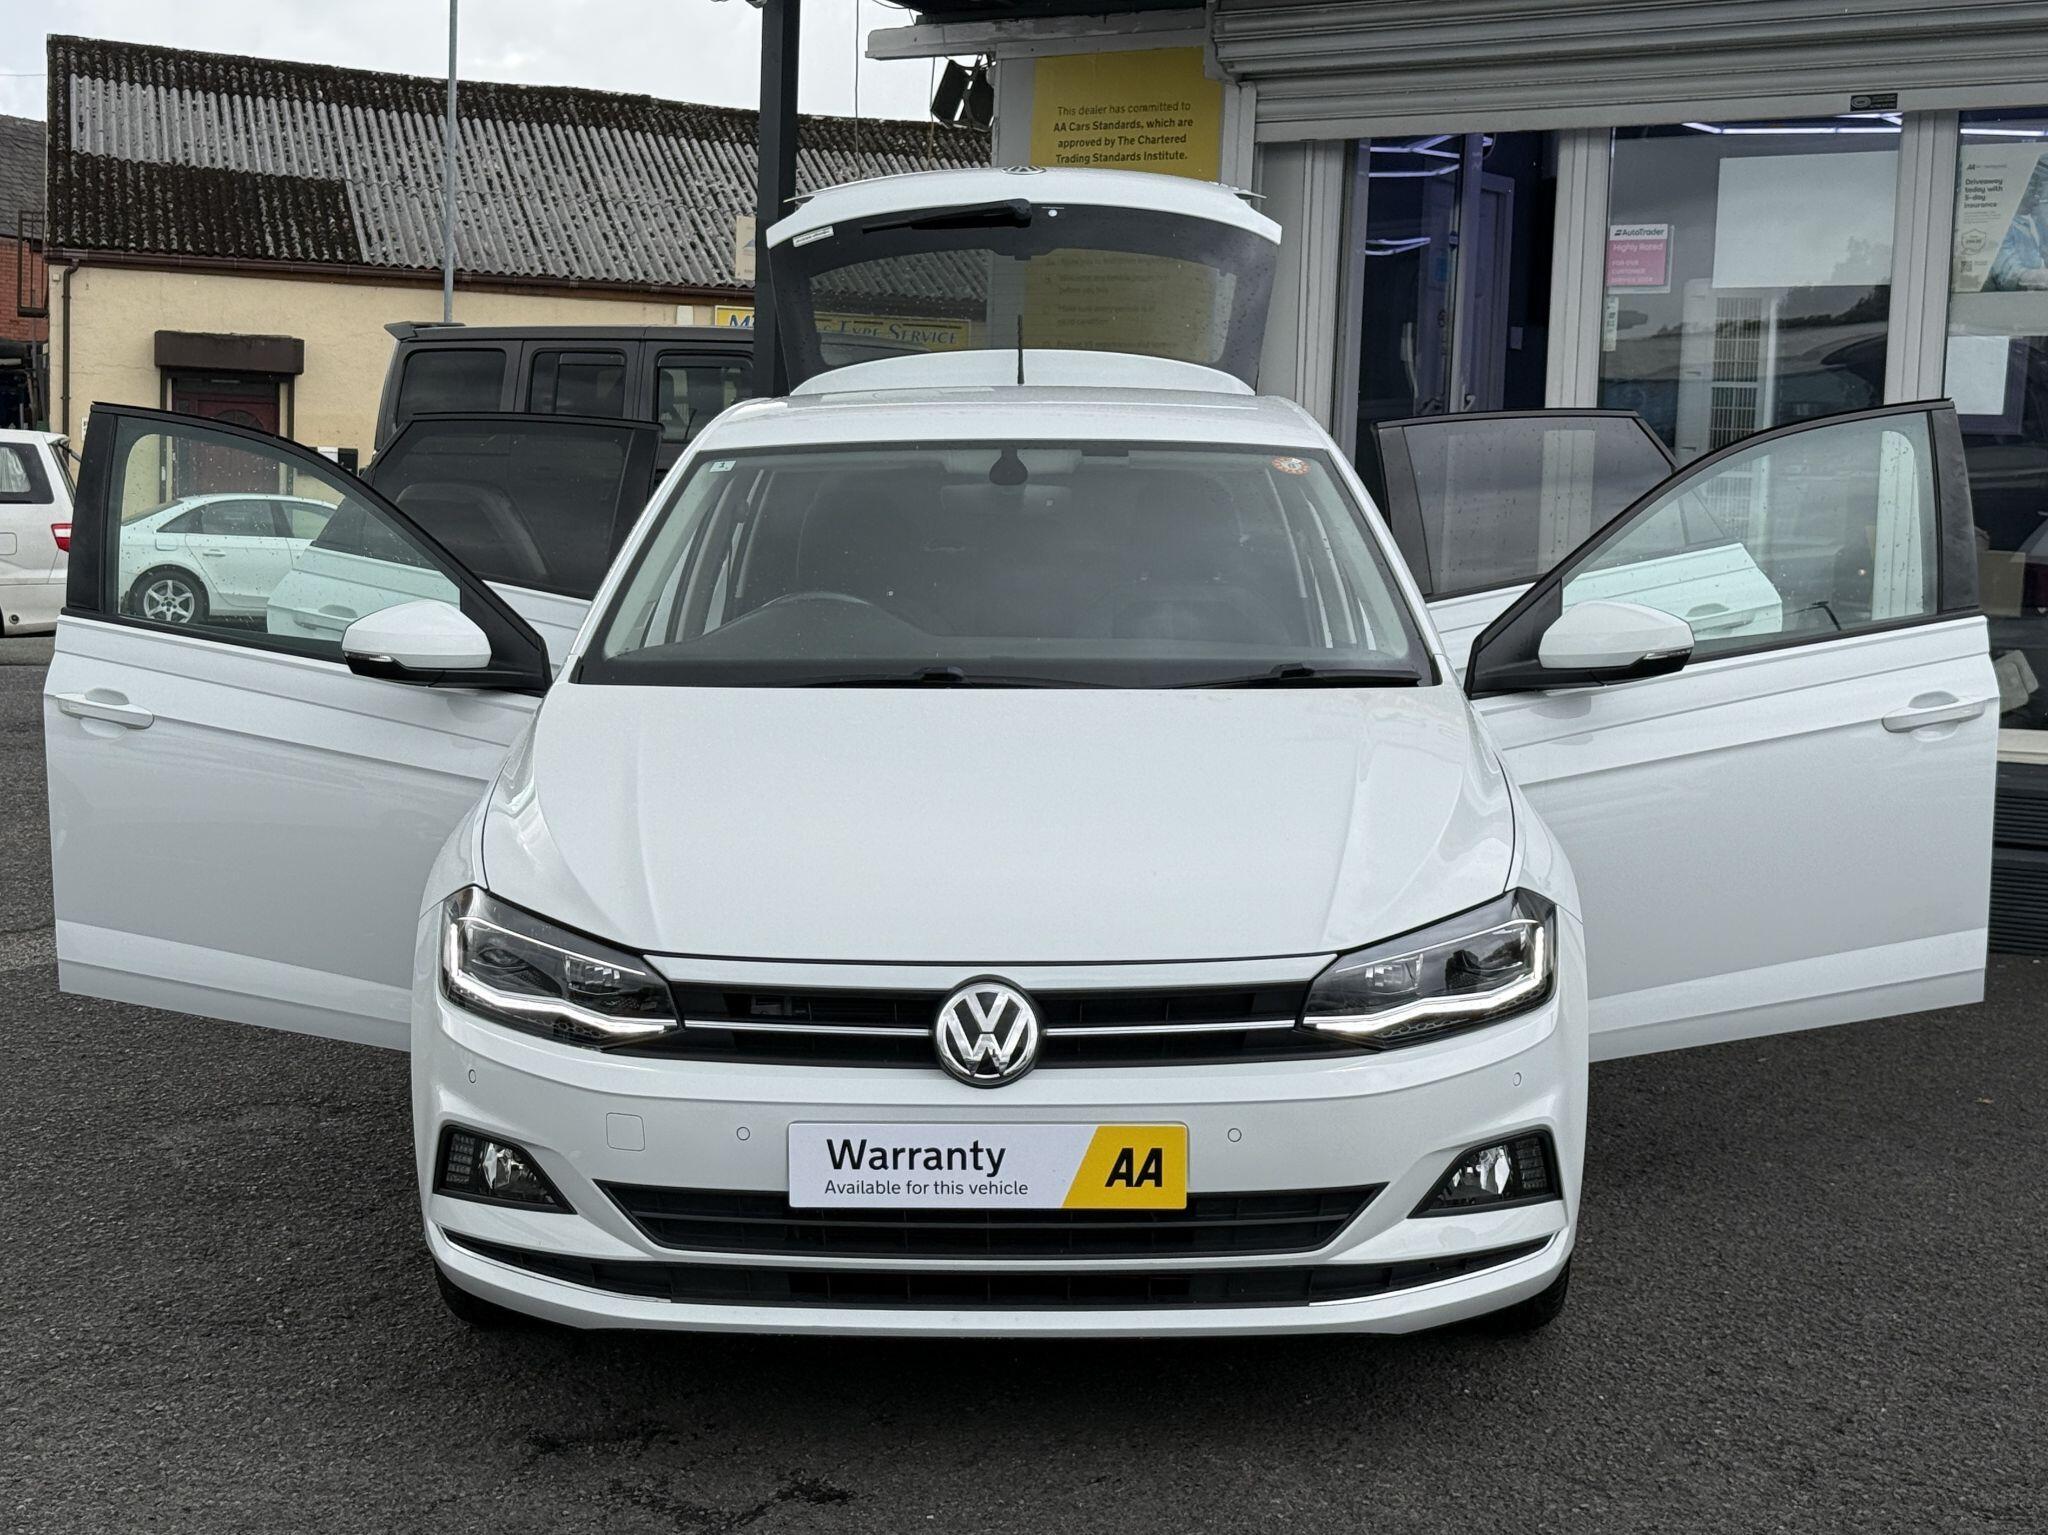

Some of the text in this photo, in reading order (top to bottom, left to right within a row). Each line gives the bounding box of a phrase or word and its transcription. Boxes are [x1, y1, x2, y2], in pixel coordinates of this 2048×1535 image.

[1058, 102, 1191, 116] This dealer has committed to
[1053, 118, 1193, 132] AA Cars Standards, which are
[1057, 133, 1187, 149] approved by The Chartered
[1056, 151, 1188, 165] Trading Standards Institute.
[1622, 228, 1664, 237] AutoTrader
[1612, 242, 1663, 253] Highly Rated
[888, 323, 957, 344] SERVICE
[826, 1138, 1006, 1177] Warranty
[1105, 1147, 1163, 1187] AA
[825, 1179, 1028, 1195] Available for this vehicle
